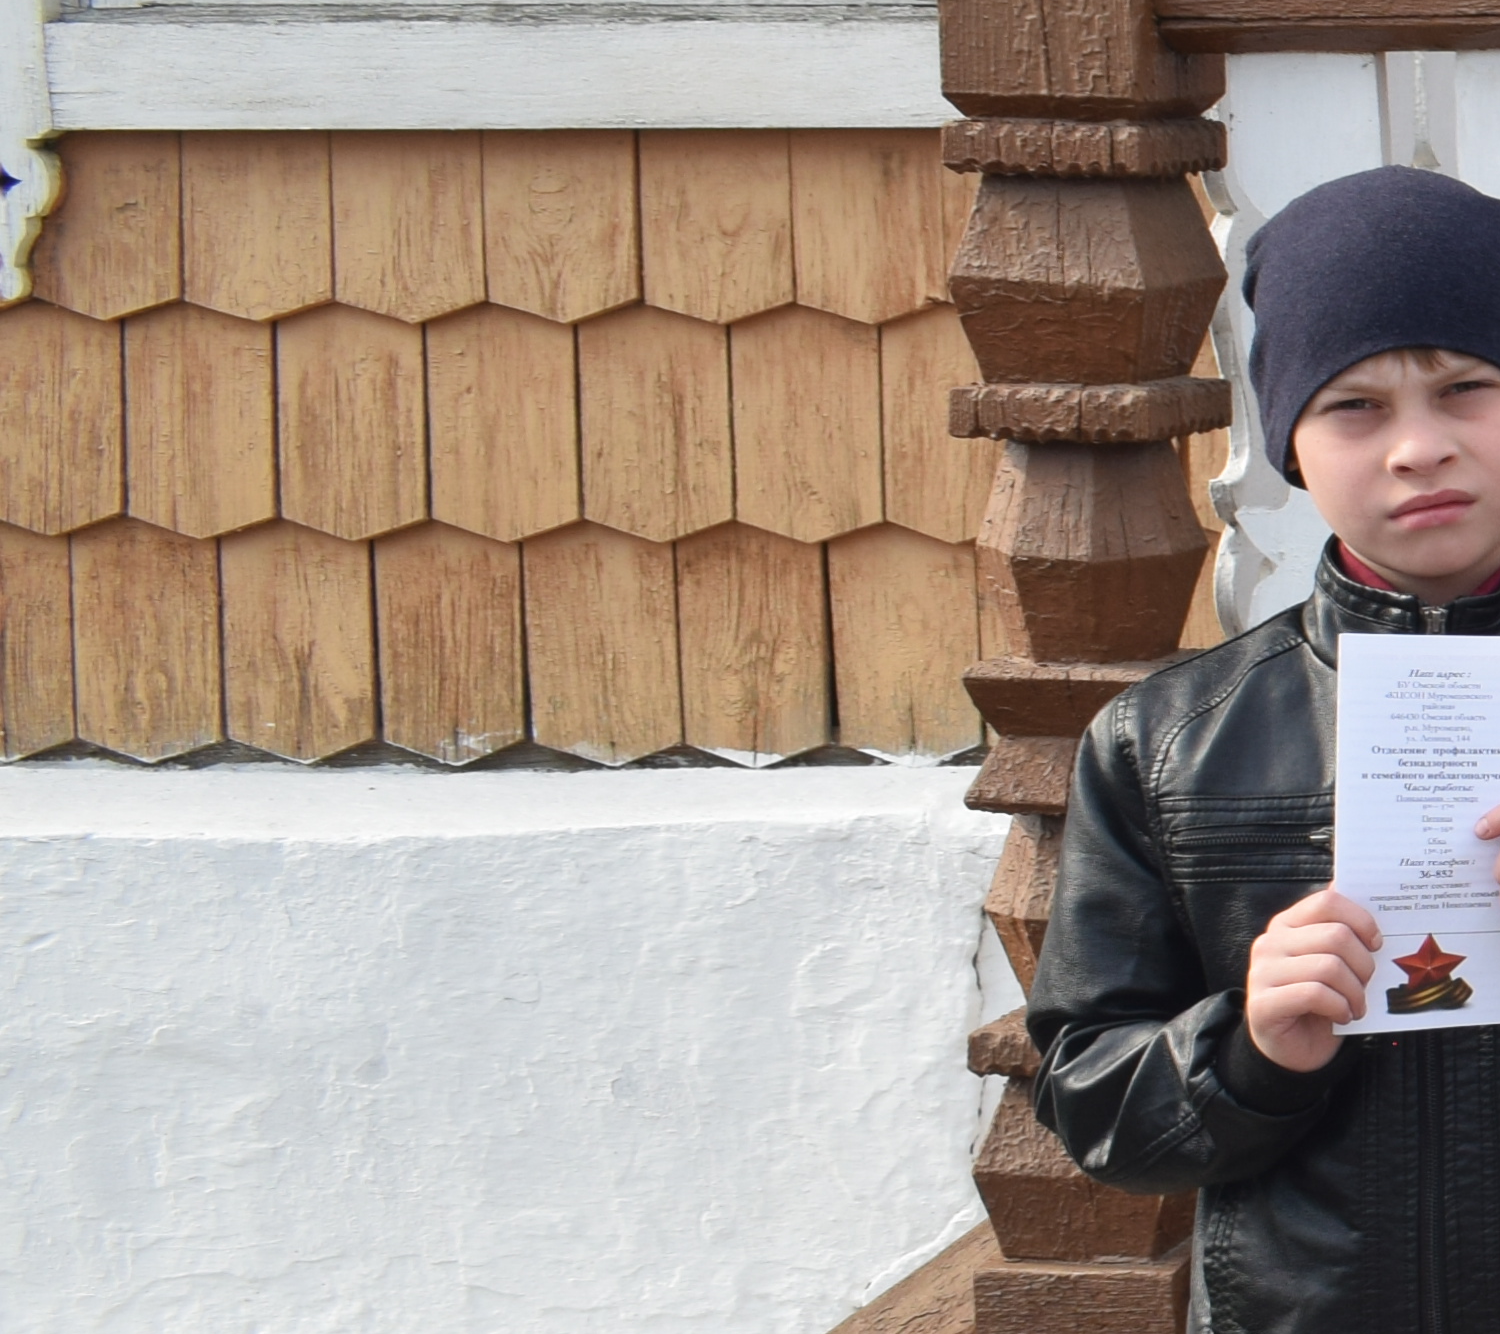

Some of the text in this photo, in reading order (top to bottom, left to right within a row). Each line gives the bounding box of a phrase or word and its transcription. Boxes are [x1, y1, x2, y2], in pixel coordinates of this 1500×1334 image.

[1371, 745, 1428, 755] Отделение
[1397, 758, 1478, 769] безнадзорности
[1371, 771, 1425, 780] семейного
[1403, 782, 1431, 792] Часы
